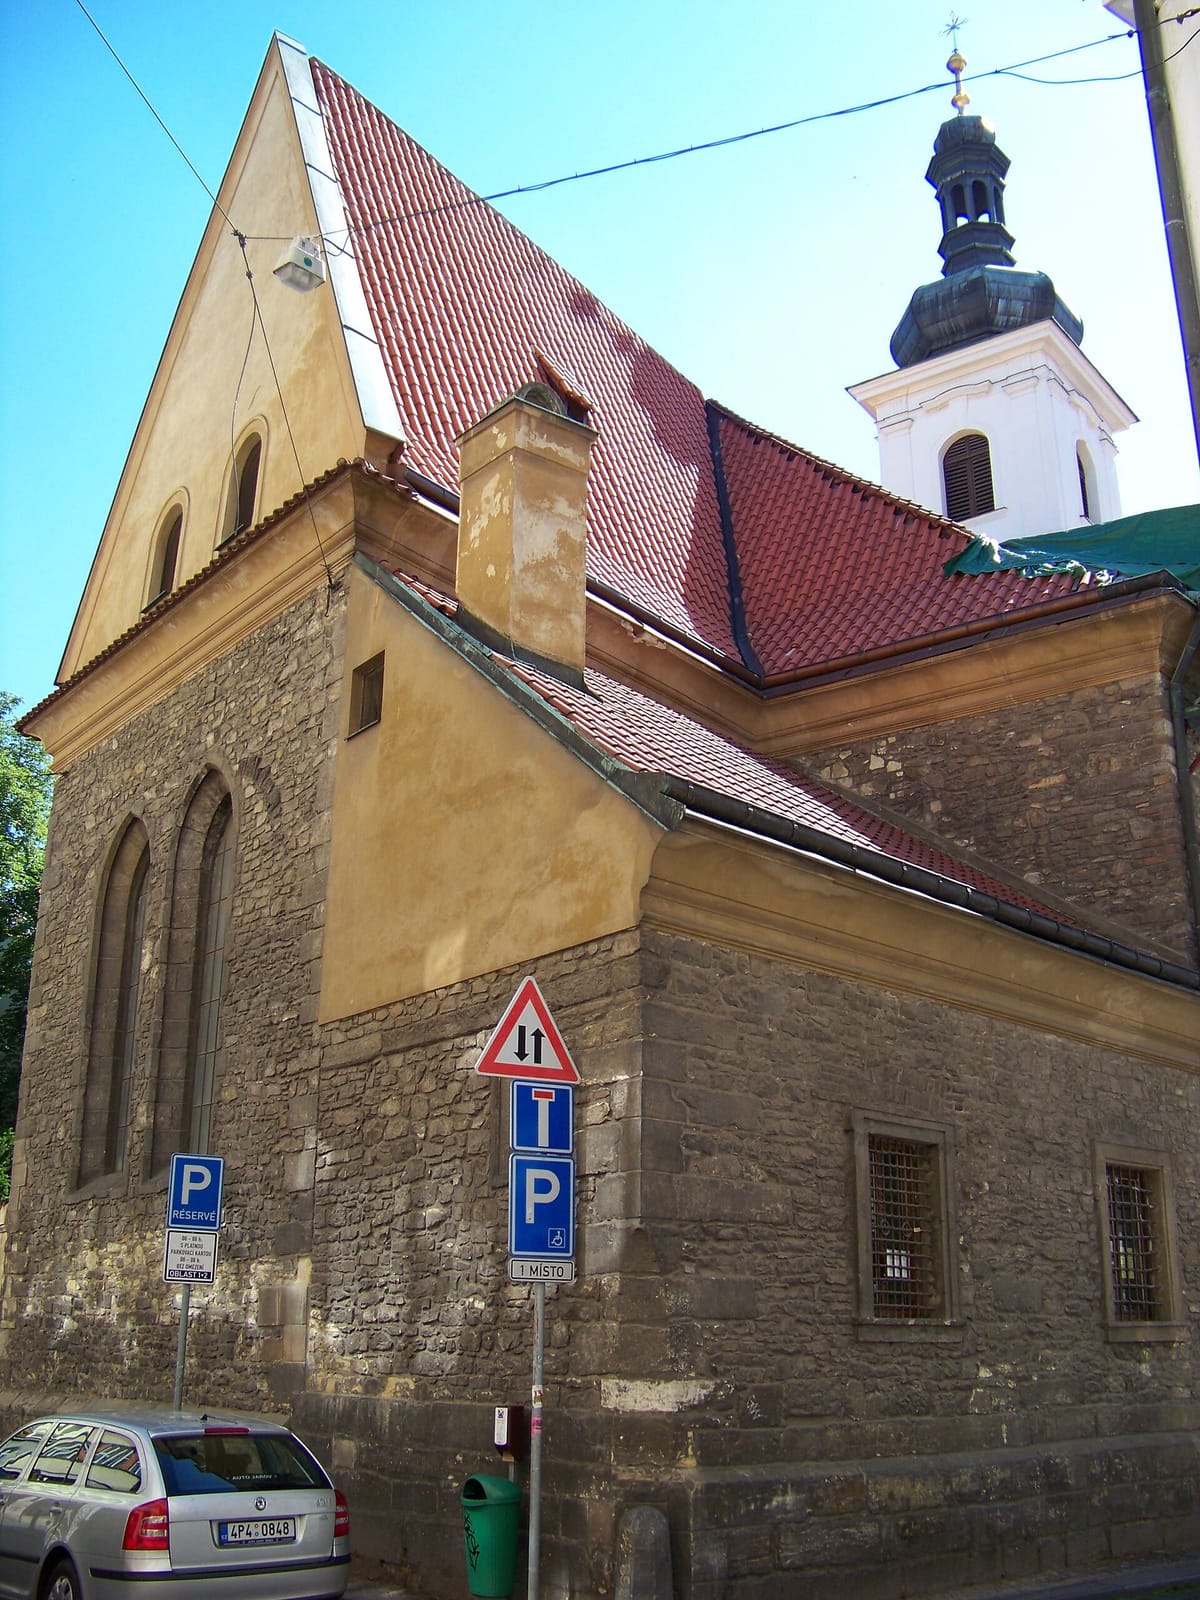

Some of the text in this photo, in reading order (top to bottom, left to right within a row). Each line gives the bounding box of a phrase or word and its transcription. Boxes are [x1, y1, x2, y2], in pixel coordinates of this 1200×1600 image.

[181, 1164, 211, 1205] P
[525, 1168, 560, 1224] P
[172, 1208, 217, 1221] RÉSERVÉ
[169, 1270, 197, 1278] OBLAST
[520, 1263, 564, 1278] 1 MÍSTO
[231, 1521, 289, 1539] 4P4 0848
